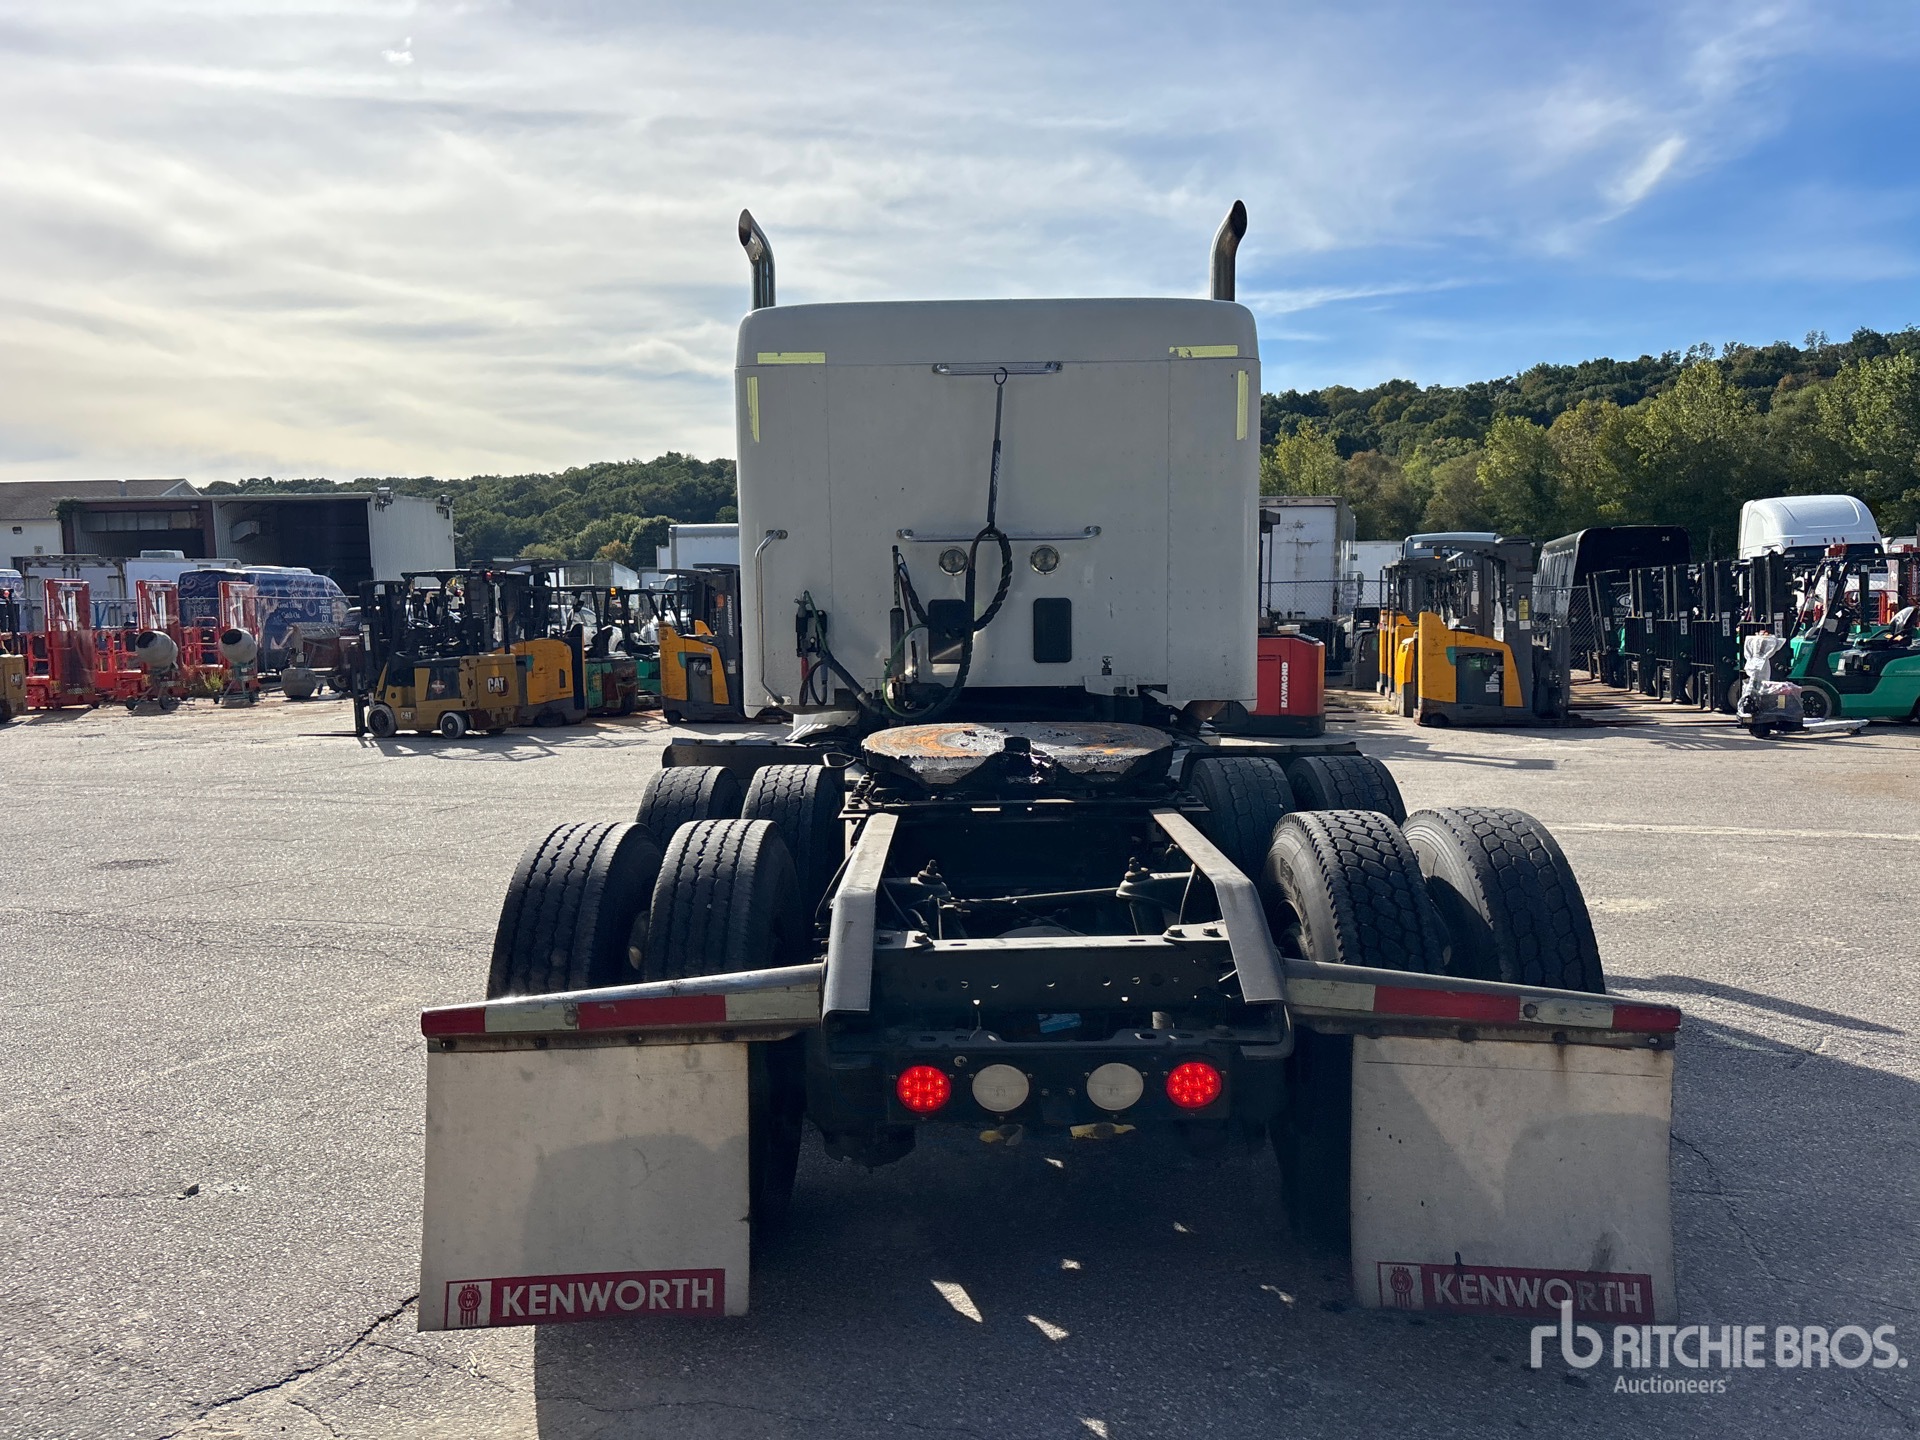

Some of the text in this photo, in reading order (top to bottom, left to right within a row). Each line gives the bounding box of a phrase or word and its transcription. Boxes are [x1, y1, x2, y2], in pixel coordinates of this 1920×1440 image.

[1458, 559, 1473, 567] 110
[487, 677, 505, 692] CAT
[1280, 661, 1289, 708] RAYMOND
[400, 711, 412, 720] CAT
[502, 1277, 714, 1317] KENWORTH
[1433, 1273, 1642, 1313] KENWORTH
